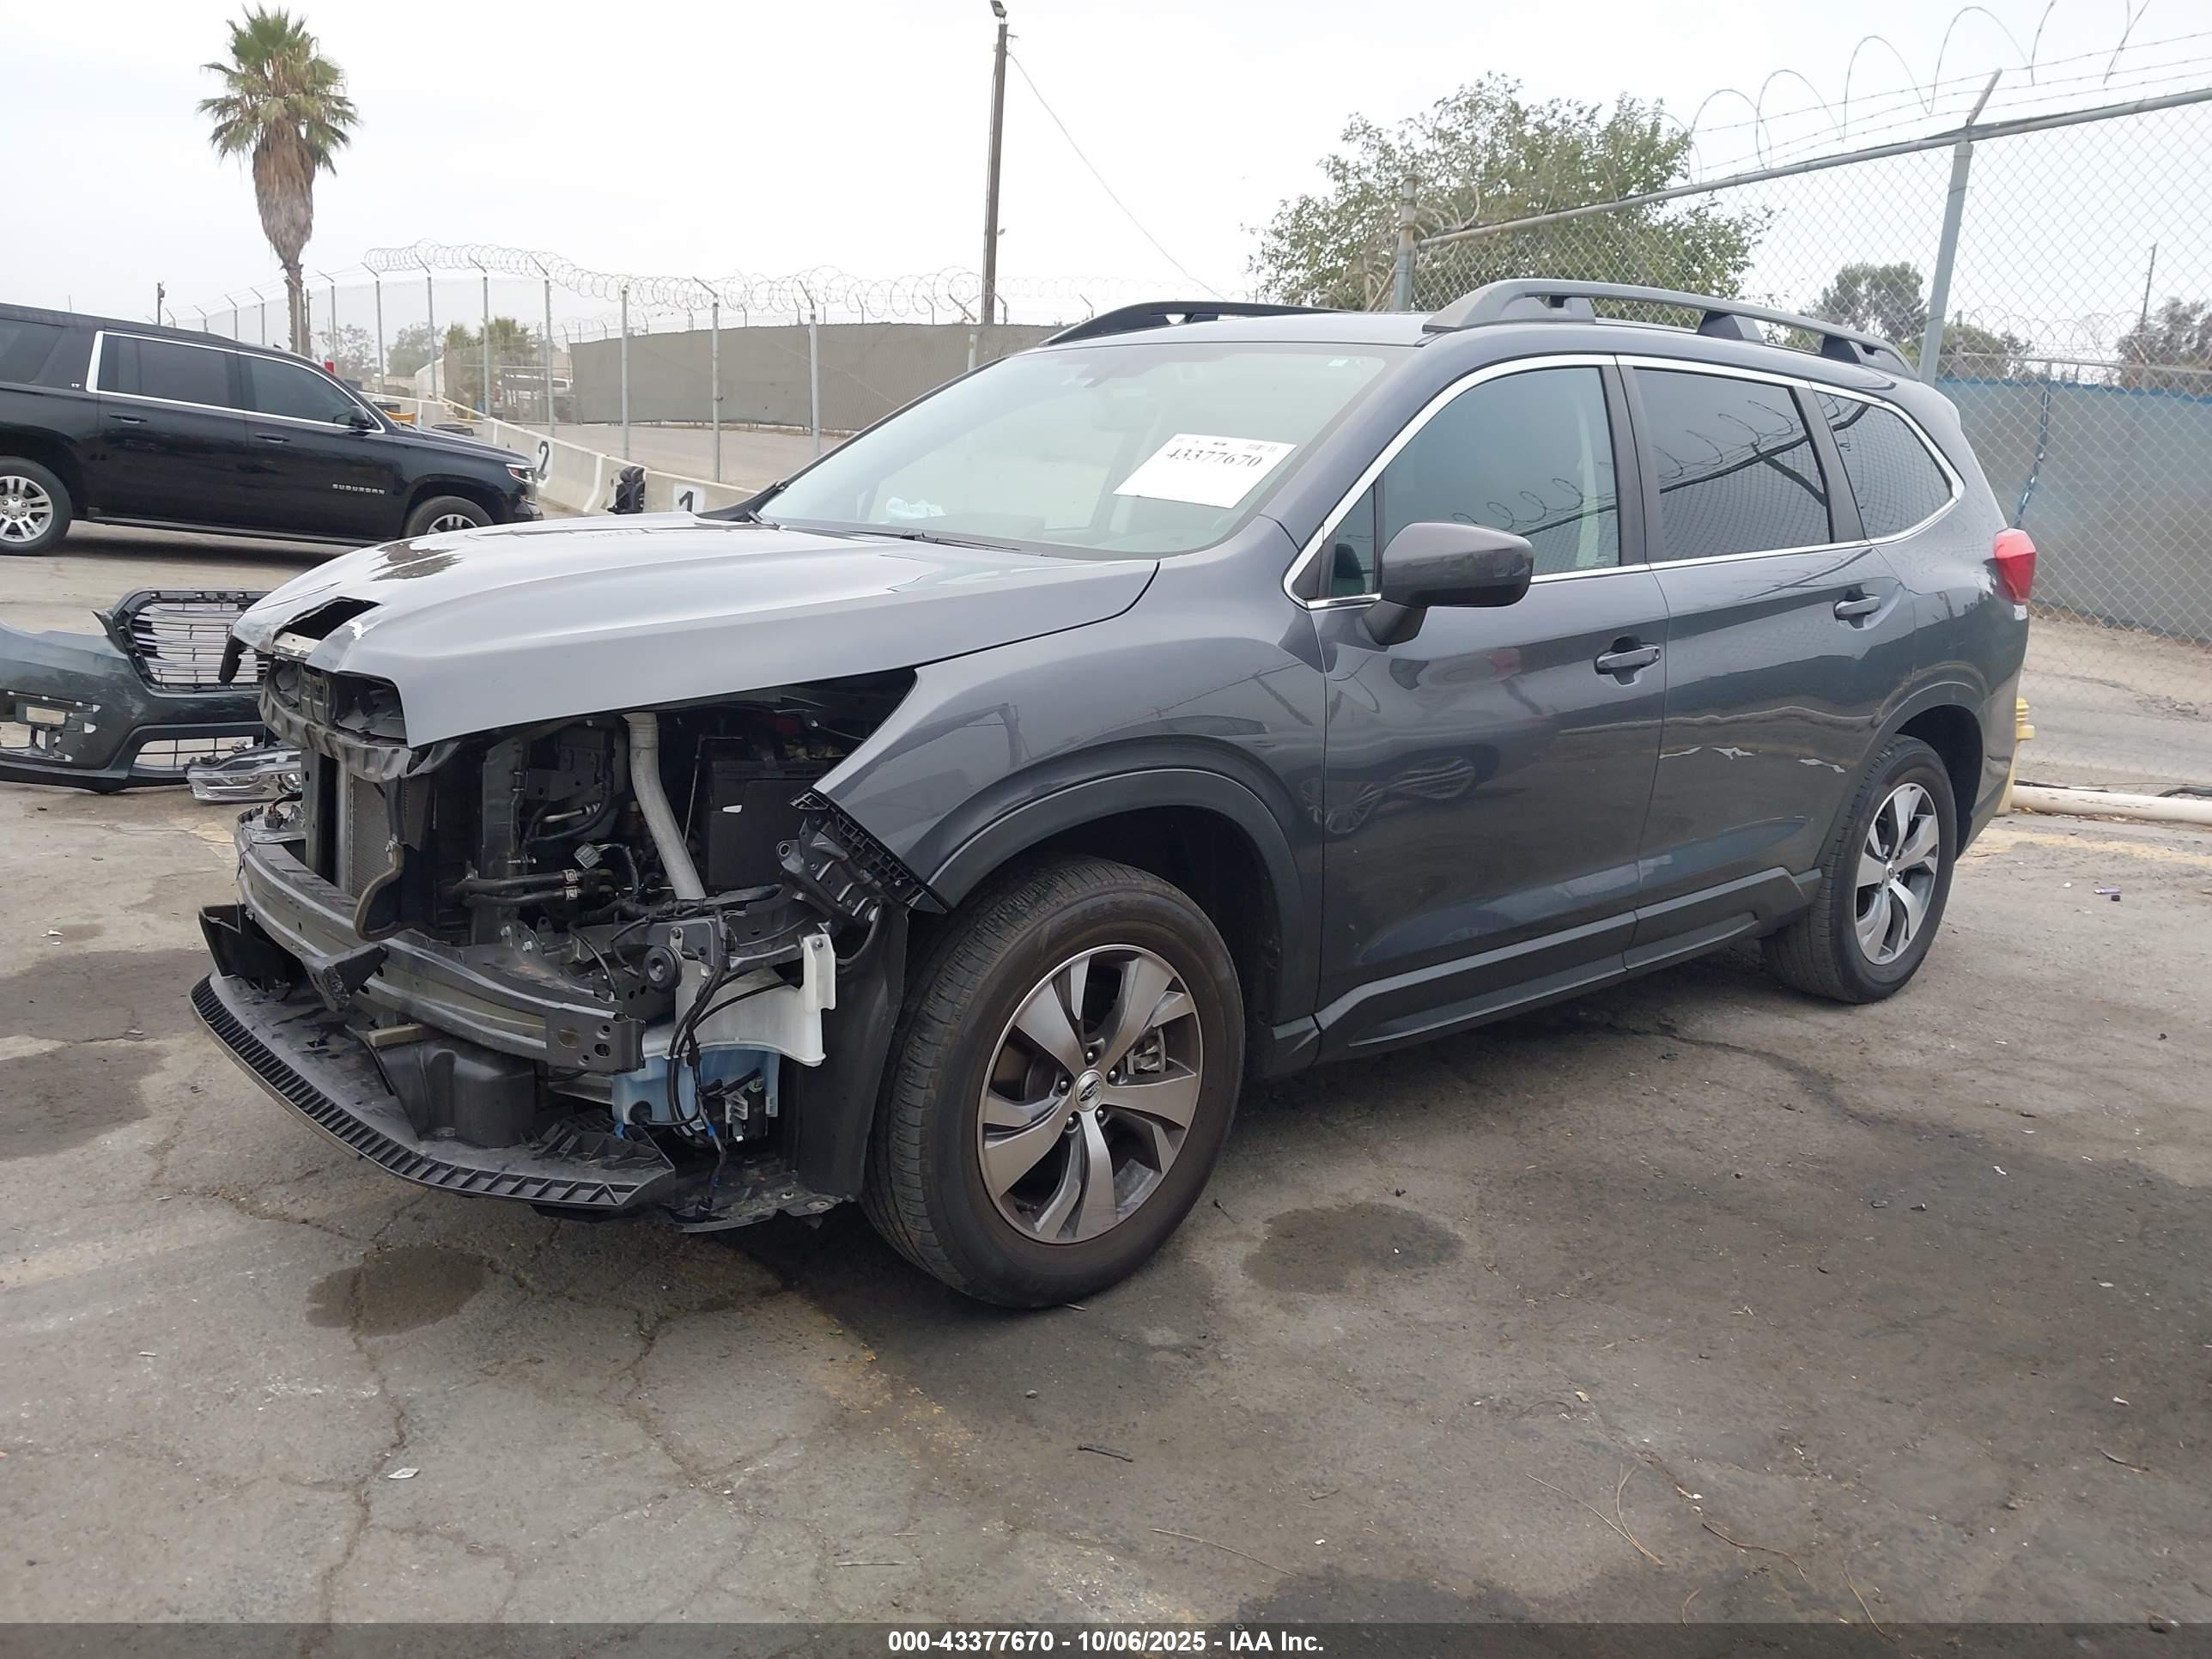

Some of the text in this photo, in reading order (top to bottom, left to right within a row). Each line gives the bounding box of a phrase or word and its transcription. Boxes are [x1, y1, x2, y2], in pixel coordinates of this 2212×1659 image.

[536, 441, 550, 481] 2
[1167, 447, 1263, 468] 43377670
[331, 483, 386, 495] SUBURBAN
[678, 490, 694, 513] 1
